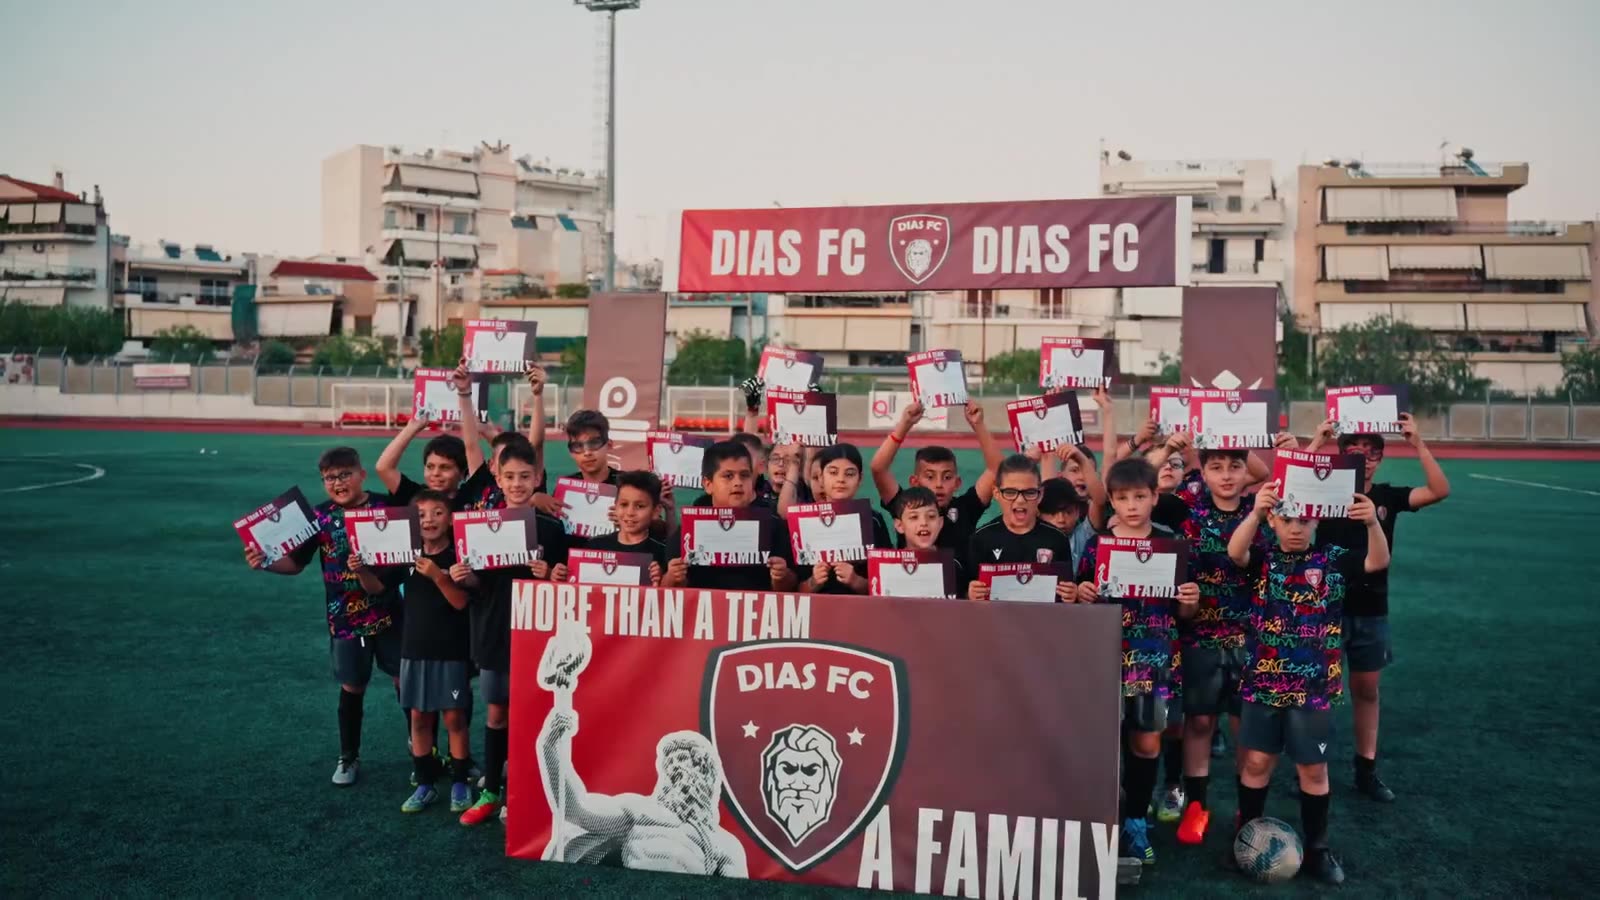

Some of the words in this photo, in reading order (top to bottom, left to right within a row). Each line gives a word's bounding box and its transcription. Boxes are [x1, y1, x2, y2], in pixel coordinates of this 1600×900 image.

[897, 220, 923, 233] DIAS
[923, 220, 943, 232] FC
[711, 229, 801, 277] DIAS
[817, 228, 866, 276] FC
[972, 224, 1070, 275] DIAS
[1088, 222, 1139, 273] FC
[445, 409, 488, 422] FAY
[1293, 452, 1310, 462] THAN
[1314, 455, 1331, 463] TEAM
[669, 474, 703, 489] FAMIL
[1311, 504, 1349, 518] FAMI
[287, 518, 321, 551] FAMILY
[493, 550, 537, 567] FAMILY
[720, 551, 771, 565] FAMILY
[1134, 584, 1181, 598] FAMIL
[511, 583, 592, 634] MORE
[602, 586, 684, 639] THAN
[693, 591, 714, 641] A
[726, 593, 811, 642] TEAM
[736, 662, 817, 692] DIAS
[826, 667, 875, 699] FC
[856, 804, 895, 890] A
[914, 807, 1119, 900] FAMILY
